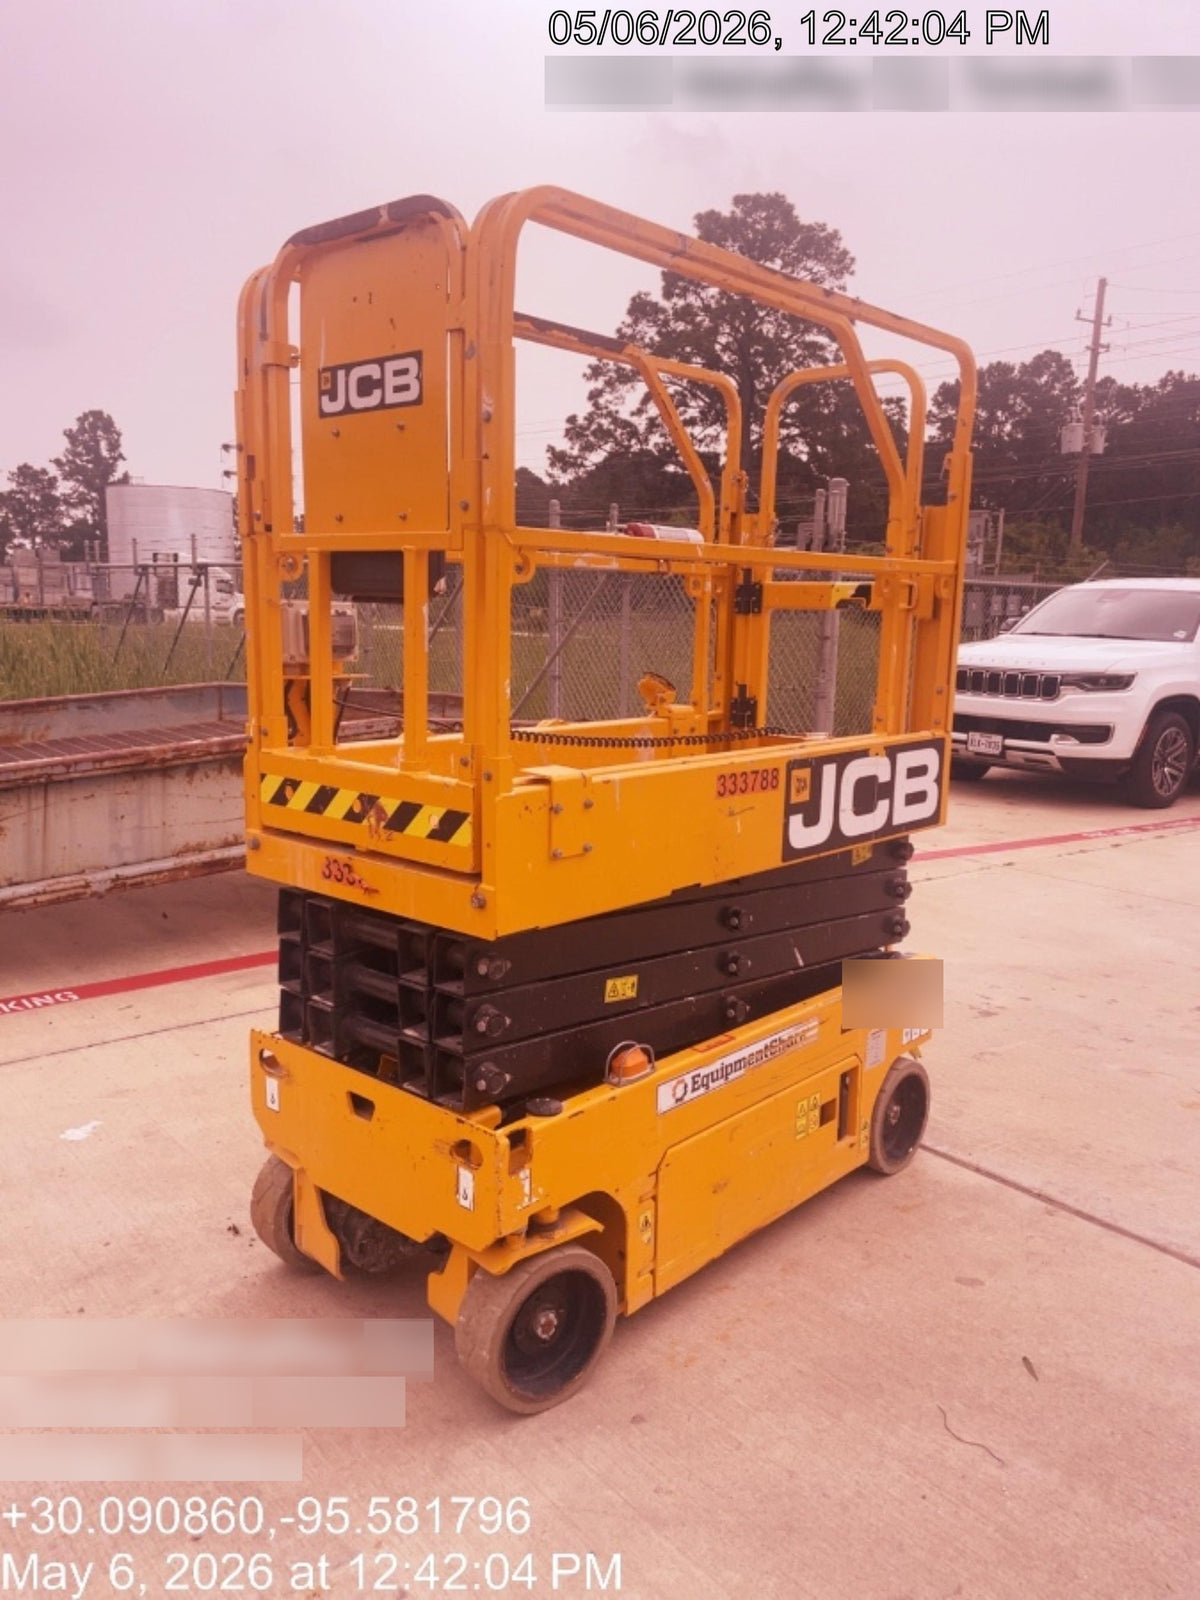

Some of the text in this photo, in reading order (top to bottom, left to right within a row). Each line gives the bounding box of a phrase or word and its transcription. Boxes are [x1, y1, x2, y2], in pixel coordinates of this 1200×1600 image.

[321, 357, 420, 413] JCB
[717, 768, 779, 797] 333788
[788, 748, 940, 849] JCB
[0, 991, 79, 1013] KING
